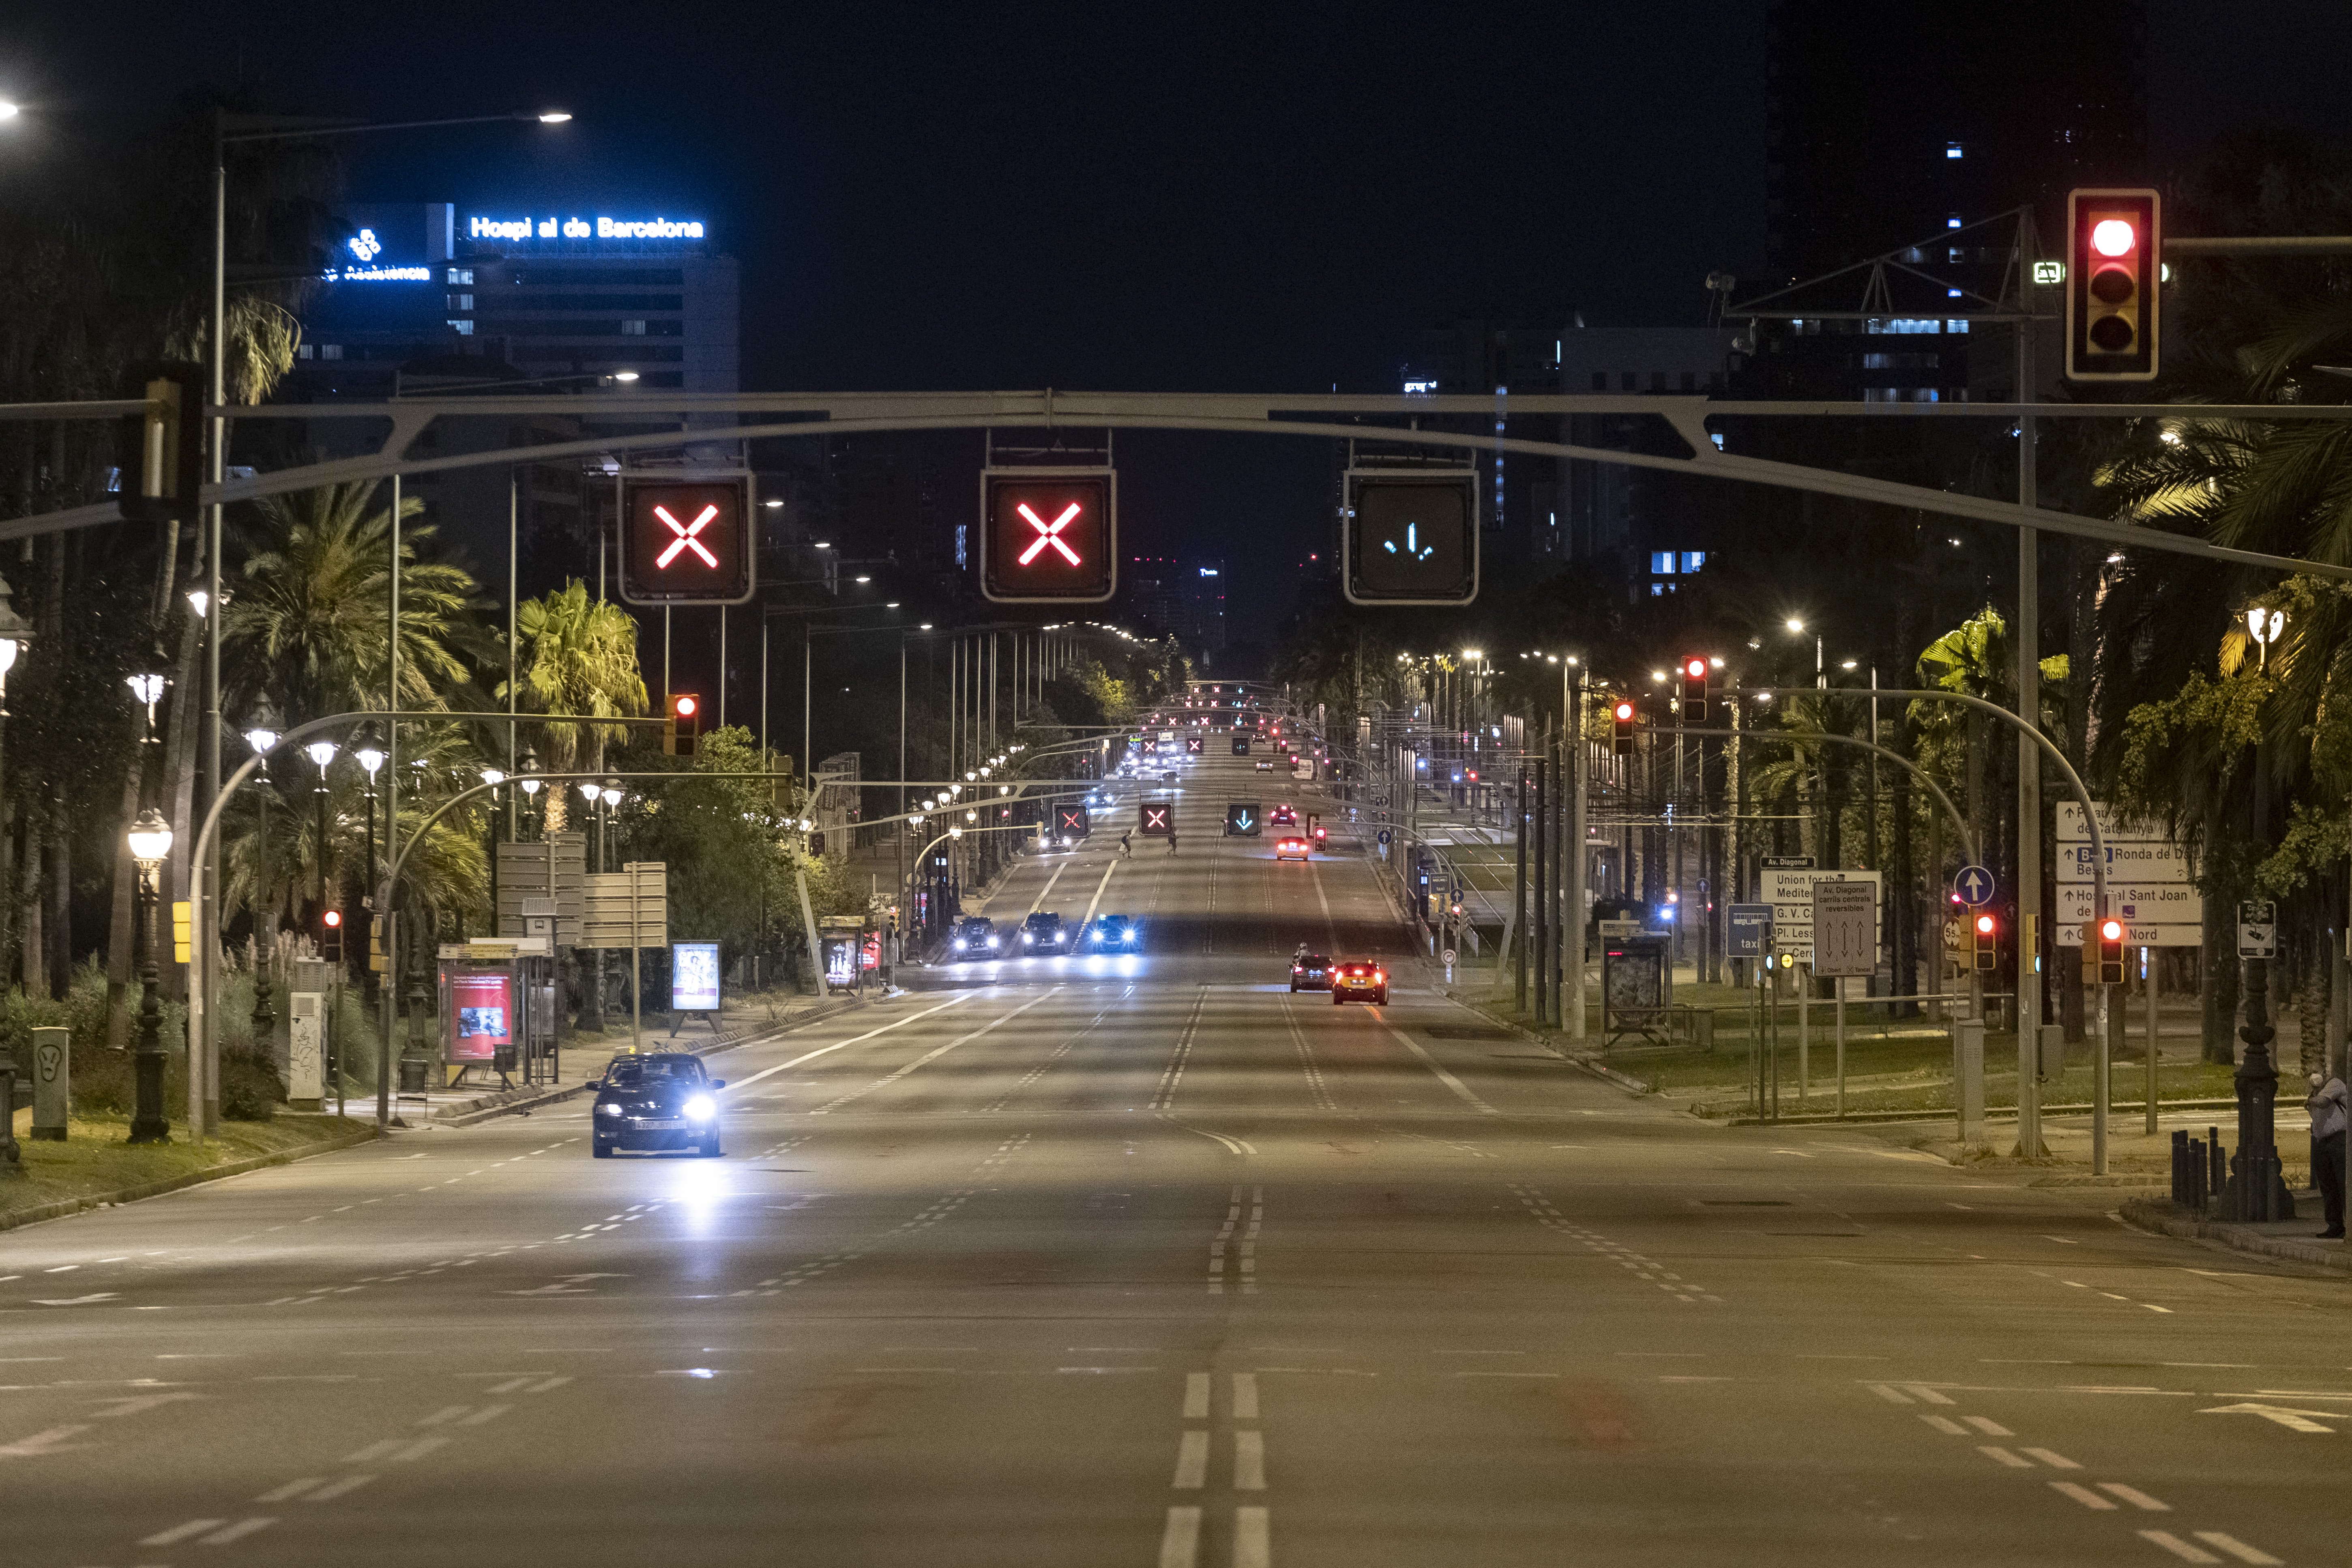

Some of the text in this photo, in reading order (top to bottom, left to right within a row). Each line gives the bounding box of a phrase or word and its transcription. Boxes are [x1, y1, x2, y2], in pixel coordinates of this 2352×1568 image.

[471, 216, 703, 240] Hospial de Barcelona
[2116, 849, 2152, 859] Ronda
[2157, 849, 2170, 859] de
[1780, 858, 1807, 867] Diagonal
[1777, 875, 1805, 884] Union
[1823, 886, 1867, 895] Av. Diagonal
[1819, 895, 1870, 903] carrils centrals
[2129, 890, 2156, 901] Sant
[2160, 890, 2187, 901] Joan
[1826, 904, 1864, 912] reversibles
[2077, 905, 2091, 916] de
[1777, 908, 1787, 918] G.
[1791, 908, 1800, 918] V.
[1777, 928, 1789, 937] Pl.
[2129, 929, 2157, 940] Nord
[1741, 939, 1760, 948] taxi
